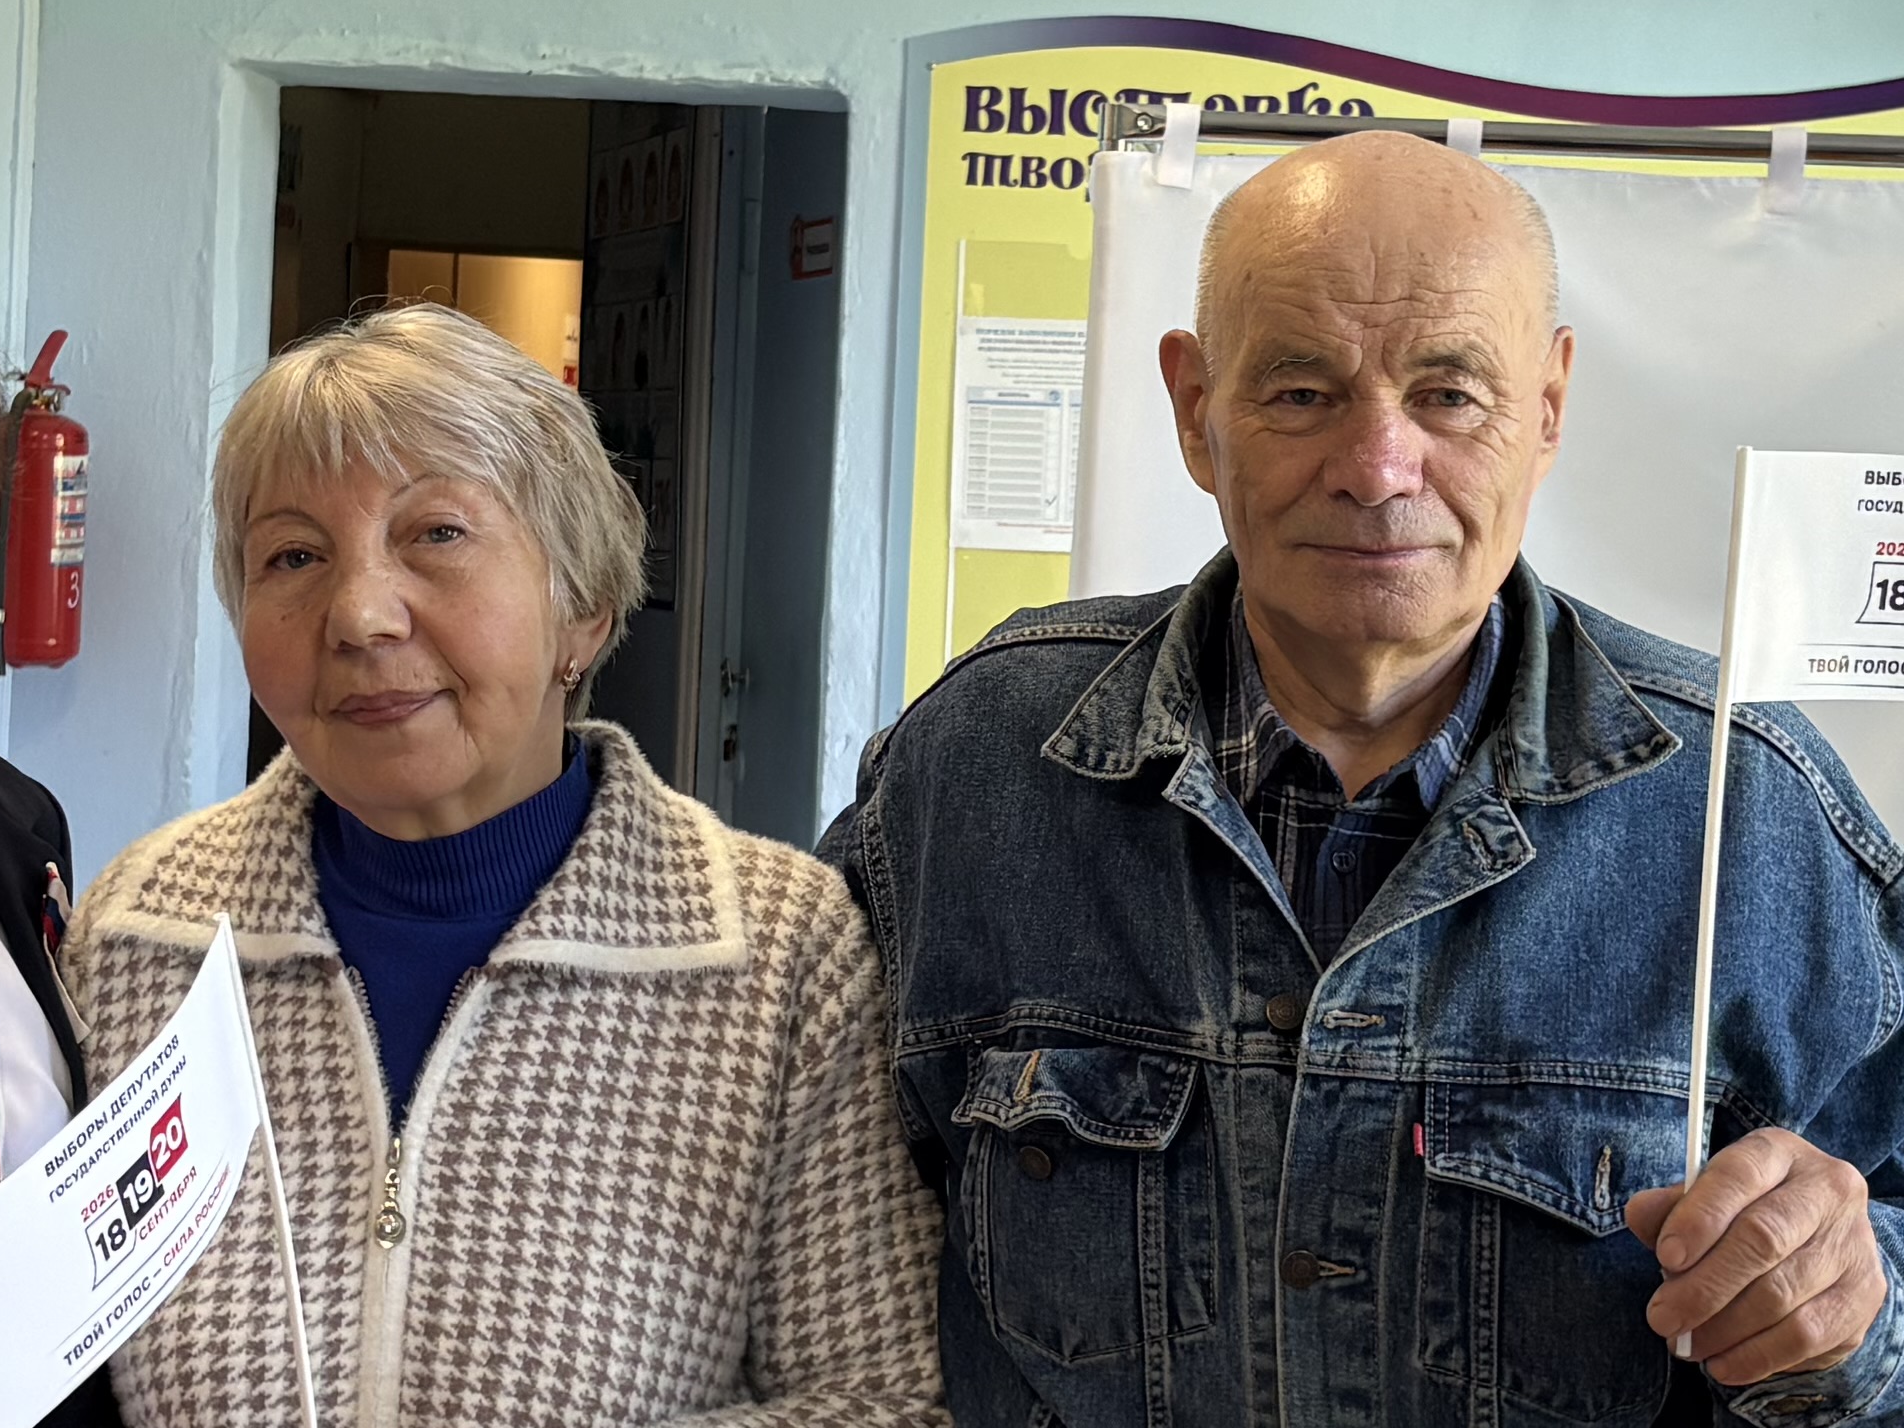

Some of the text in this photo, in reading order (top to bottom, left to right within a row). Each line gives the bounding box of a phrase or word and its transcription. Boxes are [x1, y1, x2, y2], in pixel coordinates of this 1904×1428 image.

[68, 571, 80, 609] 3
[1808, 655, 1850, 675] ТВОЙ
[44, 1034, 180, 1177] ВЫБОРЫ ДЕПУТАТОВ
[49, 1055, 187, 1203] ГОСУДАРСТВЕННОЙ ДУМЫ
[80, 1184, 115, 1222] 2026
[94, 1116, 183, 1263] 18 19 20
[139, 1165, 198, 1241] СЕНТЯБРЯ
[63, 1324, 105, 1367] ТВОЙ
[105, 1275, 152, 1336] ГОЛОС
[163, 1226, 195, 1267] СИЛА
